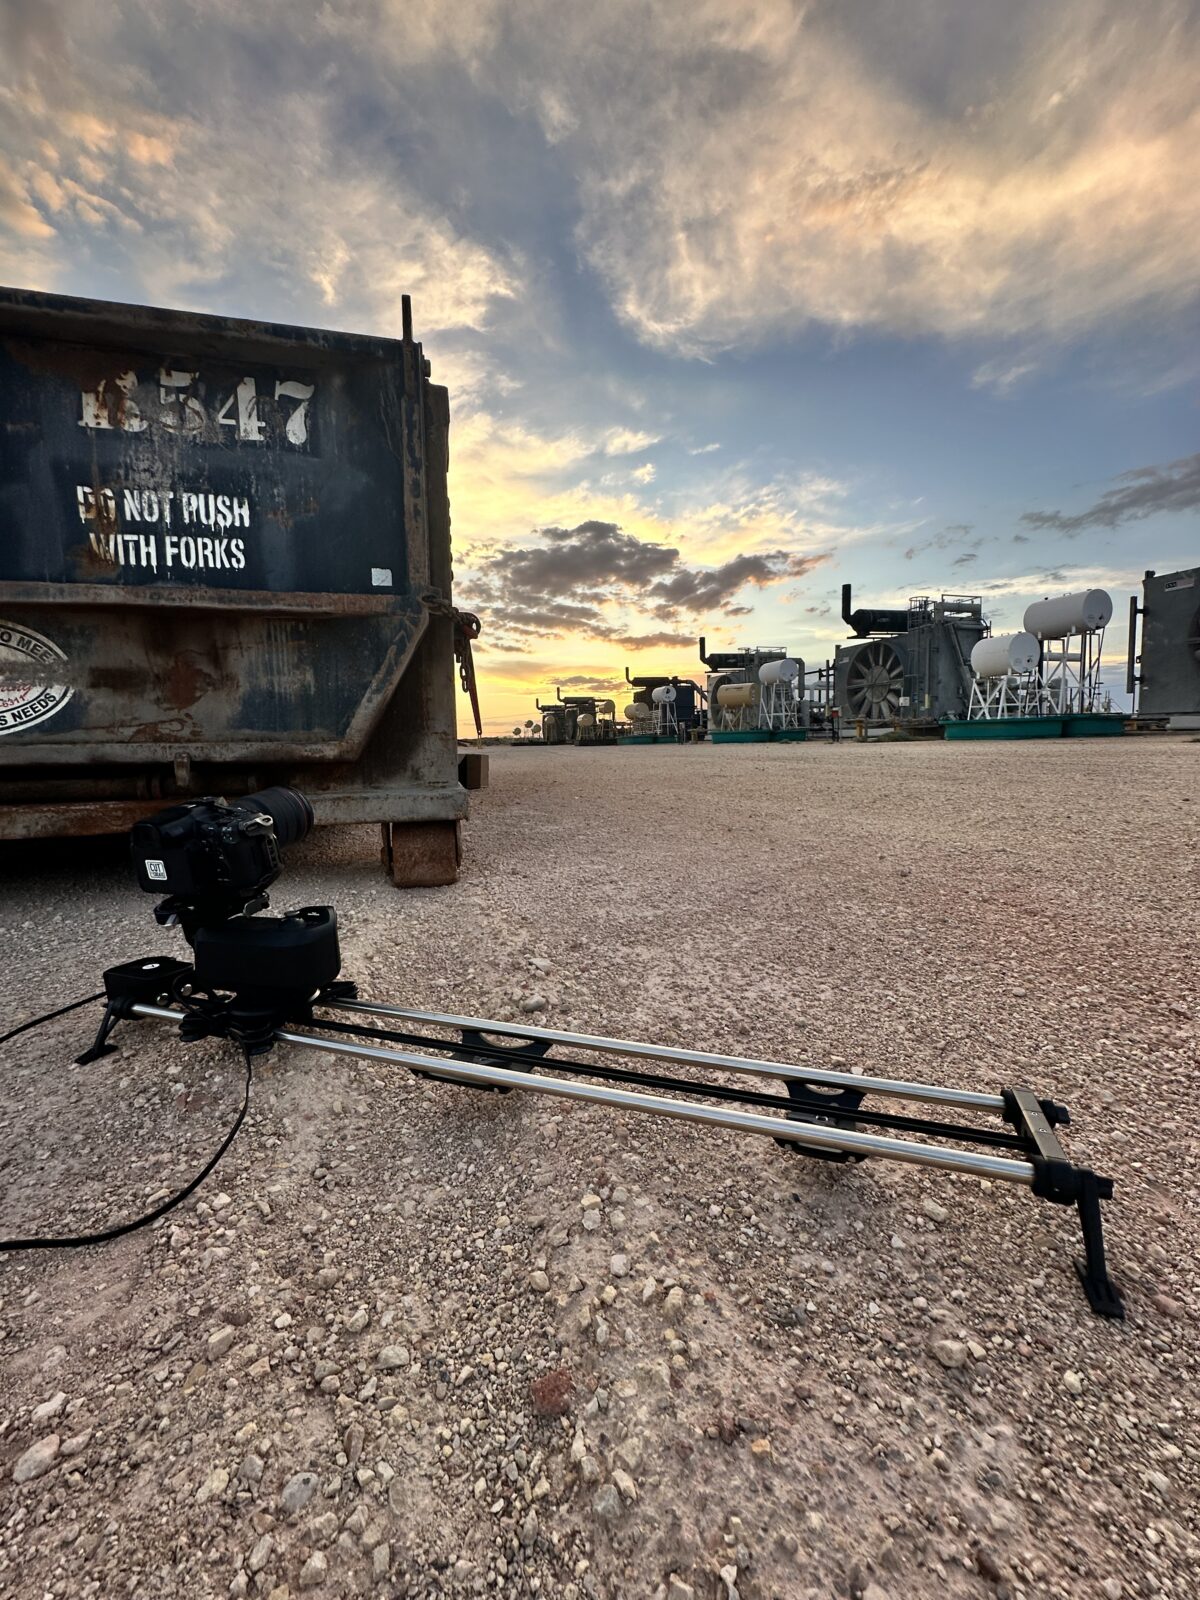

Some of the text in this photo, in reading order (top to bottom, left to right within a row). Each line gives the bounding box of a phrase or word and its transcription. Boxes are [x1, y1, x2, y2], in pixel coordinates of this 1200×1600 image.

[76, 485, 250, 530] DO NOT PUSH
[89, 532, 246, 569] WITH FORKS
[11, 692, 57, 722] NEEDS
